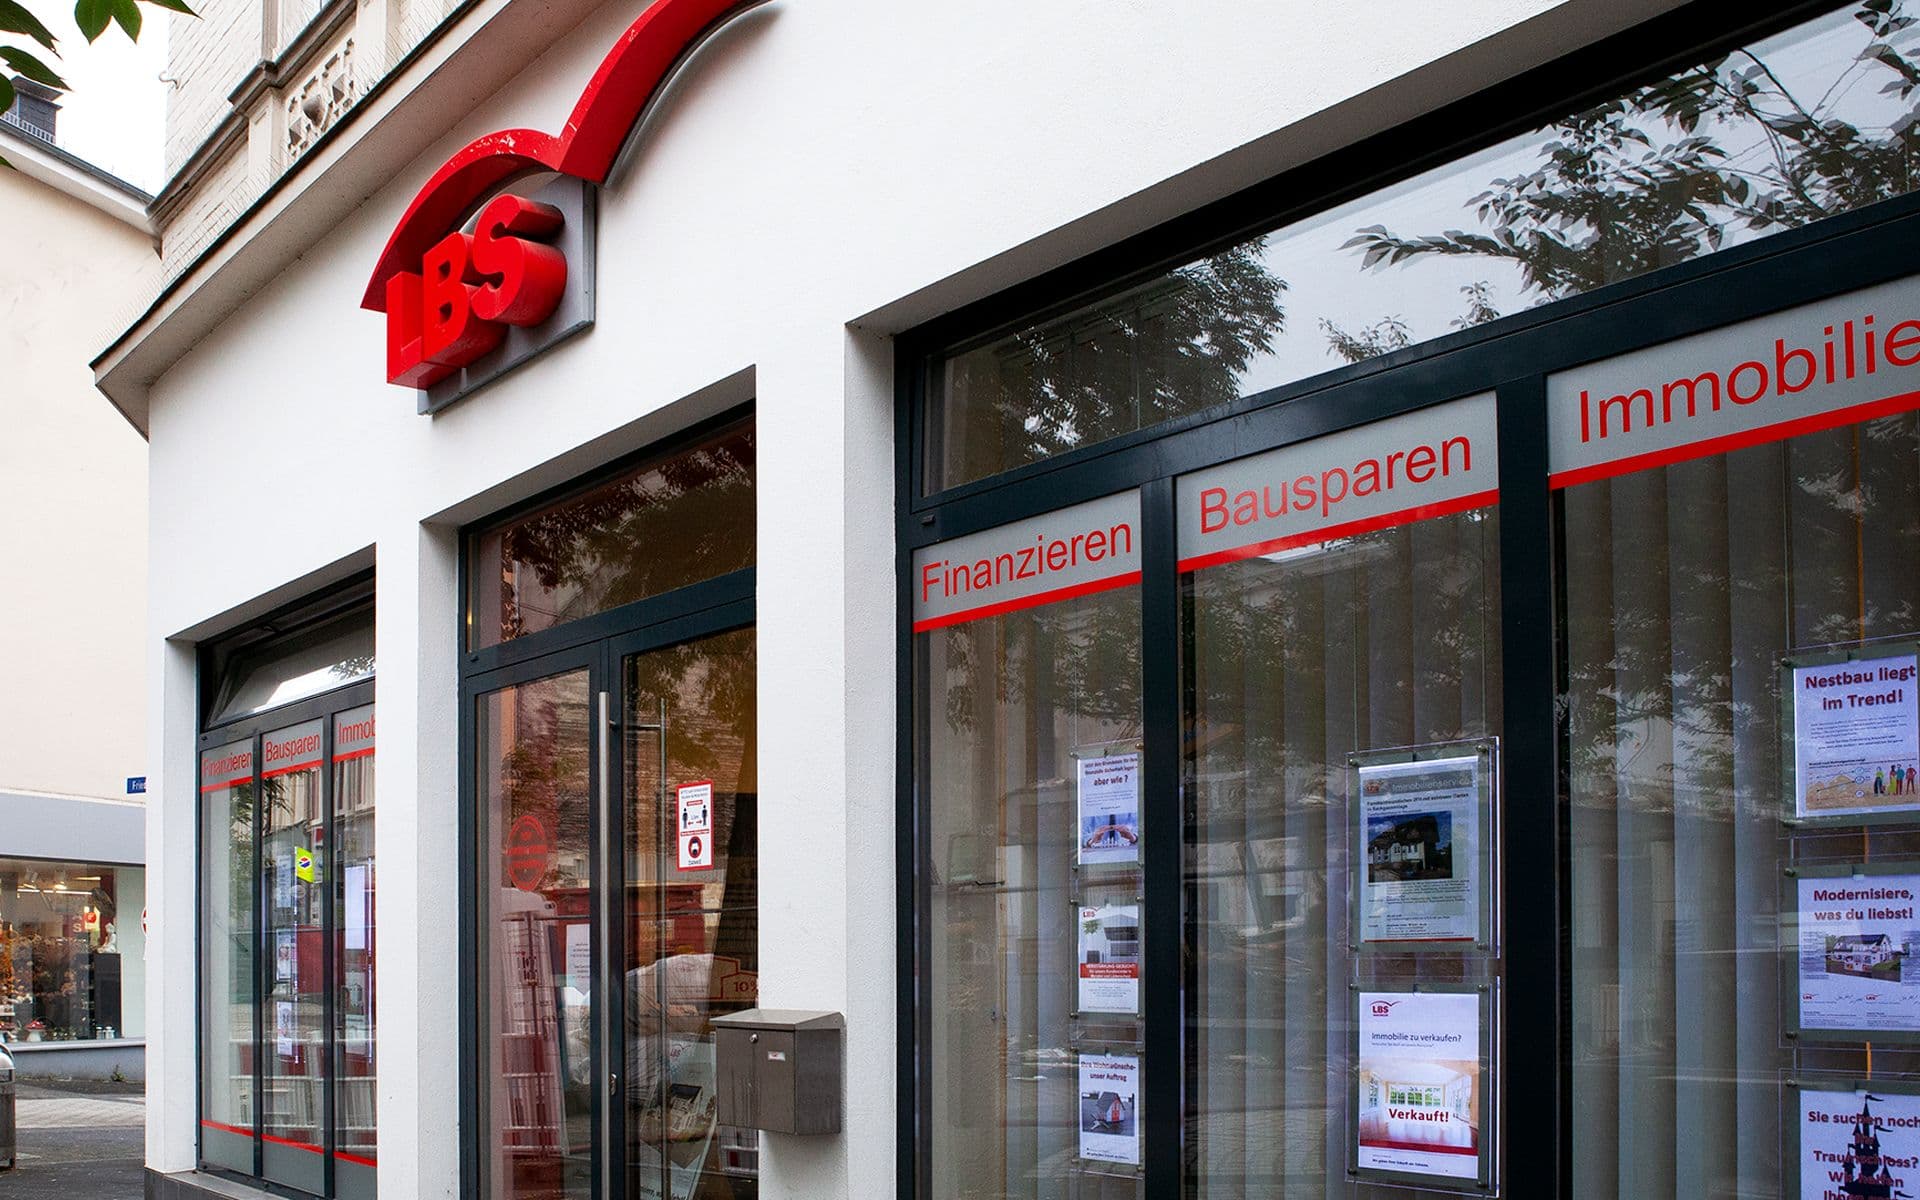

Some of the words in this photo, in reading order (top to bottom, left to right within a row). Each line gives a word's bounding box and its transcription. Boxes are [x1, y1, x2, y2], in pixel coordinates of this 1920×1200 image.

[386, 193, 552, 389] LBS
[1580, 315, 1920, 443] Immobilie
[1200, 435, 1471, 534] Bausparen
[921, 522, 1132, 603] Finanzieren
[1805, 671, 1874, 689] Nestbau
[1878, 665, 1916, 681] liegt
[1822, 697, 1843, 710] im
[1847, 688, 1903, 708] Trend!
[265, 733, 321, 762] Bausparen
[202, 751, 252, 777] Finanzieren
[1093, 778, 1109, 786] aber
[1110, 776, 1123, 784] wie
[1813, 888, 1914, 901] Modernisiere,
[1815, 911, 1842, 920] was
[1846, 908, 1864, 920] du
[1868, 907, 1913, 920] liebst!
[1372, 1005, 1389, 1013] LBS
[1371, 1032, 1409, 1041] Immobilie
[1420, 1033, 1462, 1043] verkaufen?
[1106, 1073, 1127, 1082] Auftrag
[1389, 1108, 1449, 1123] Verkauft!
[1808, 1111, 1829, 1122] Sie
[1833, 1113, 1883, 1126] suchen
[1887, 1116, 1920, 1128] noch
